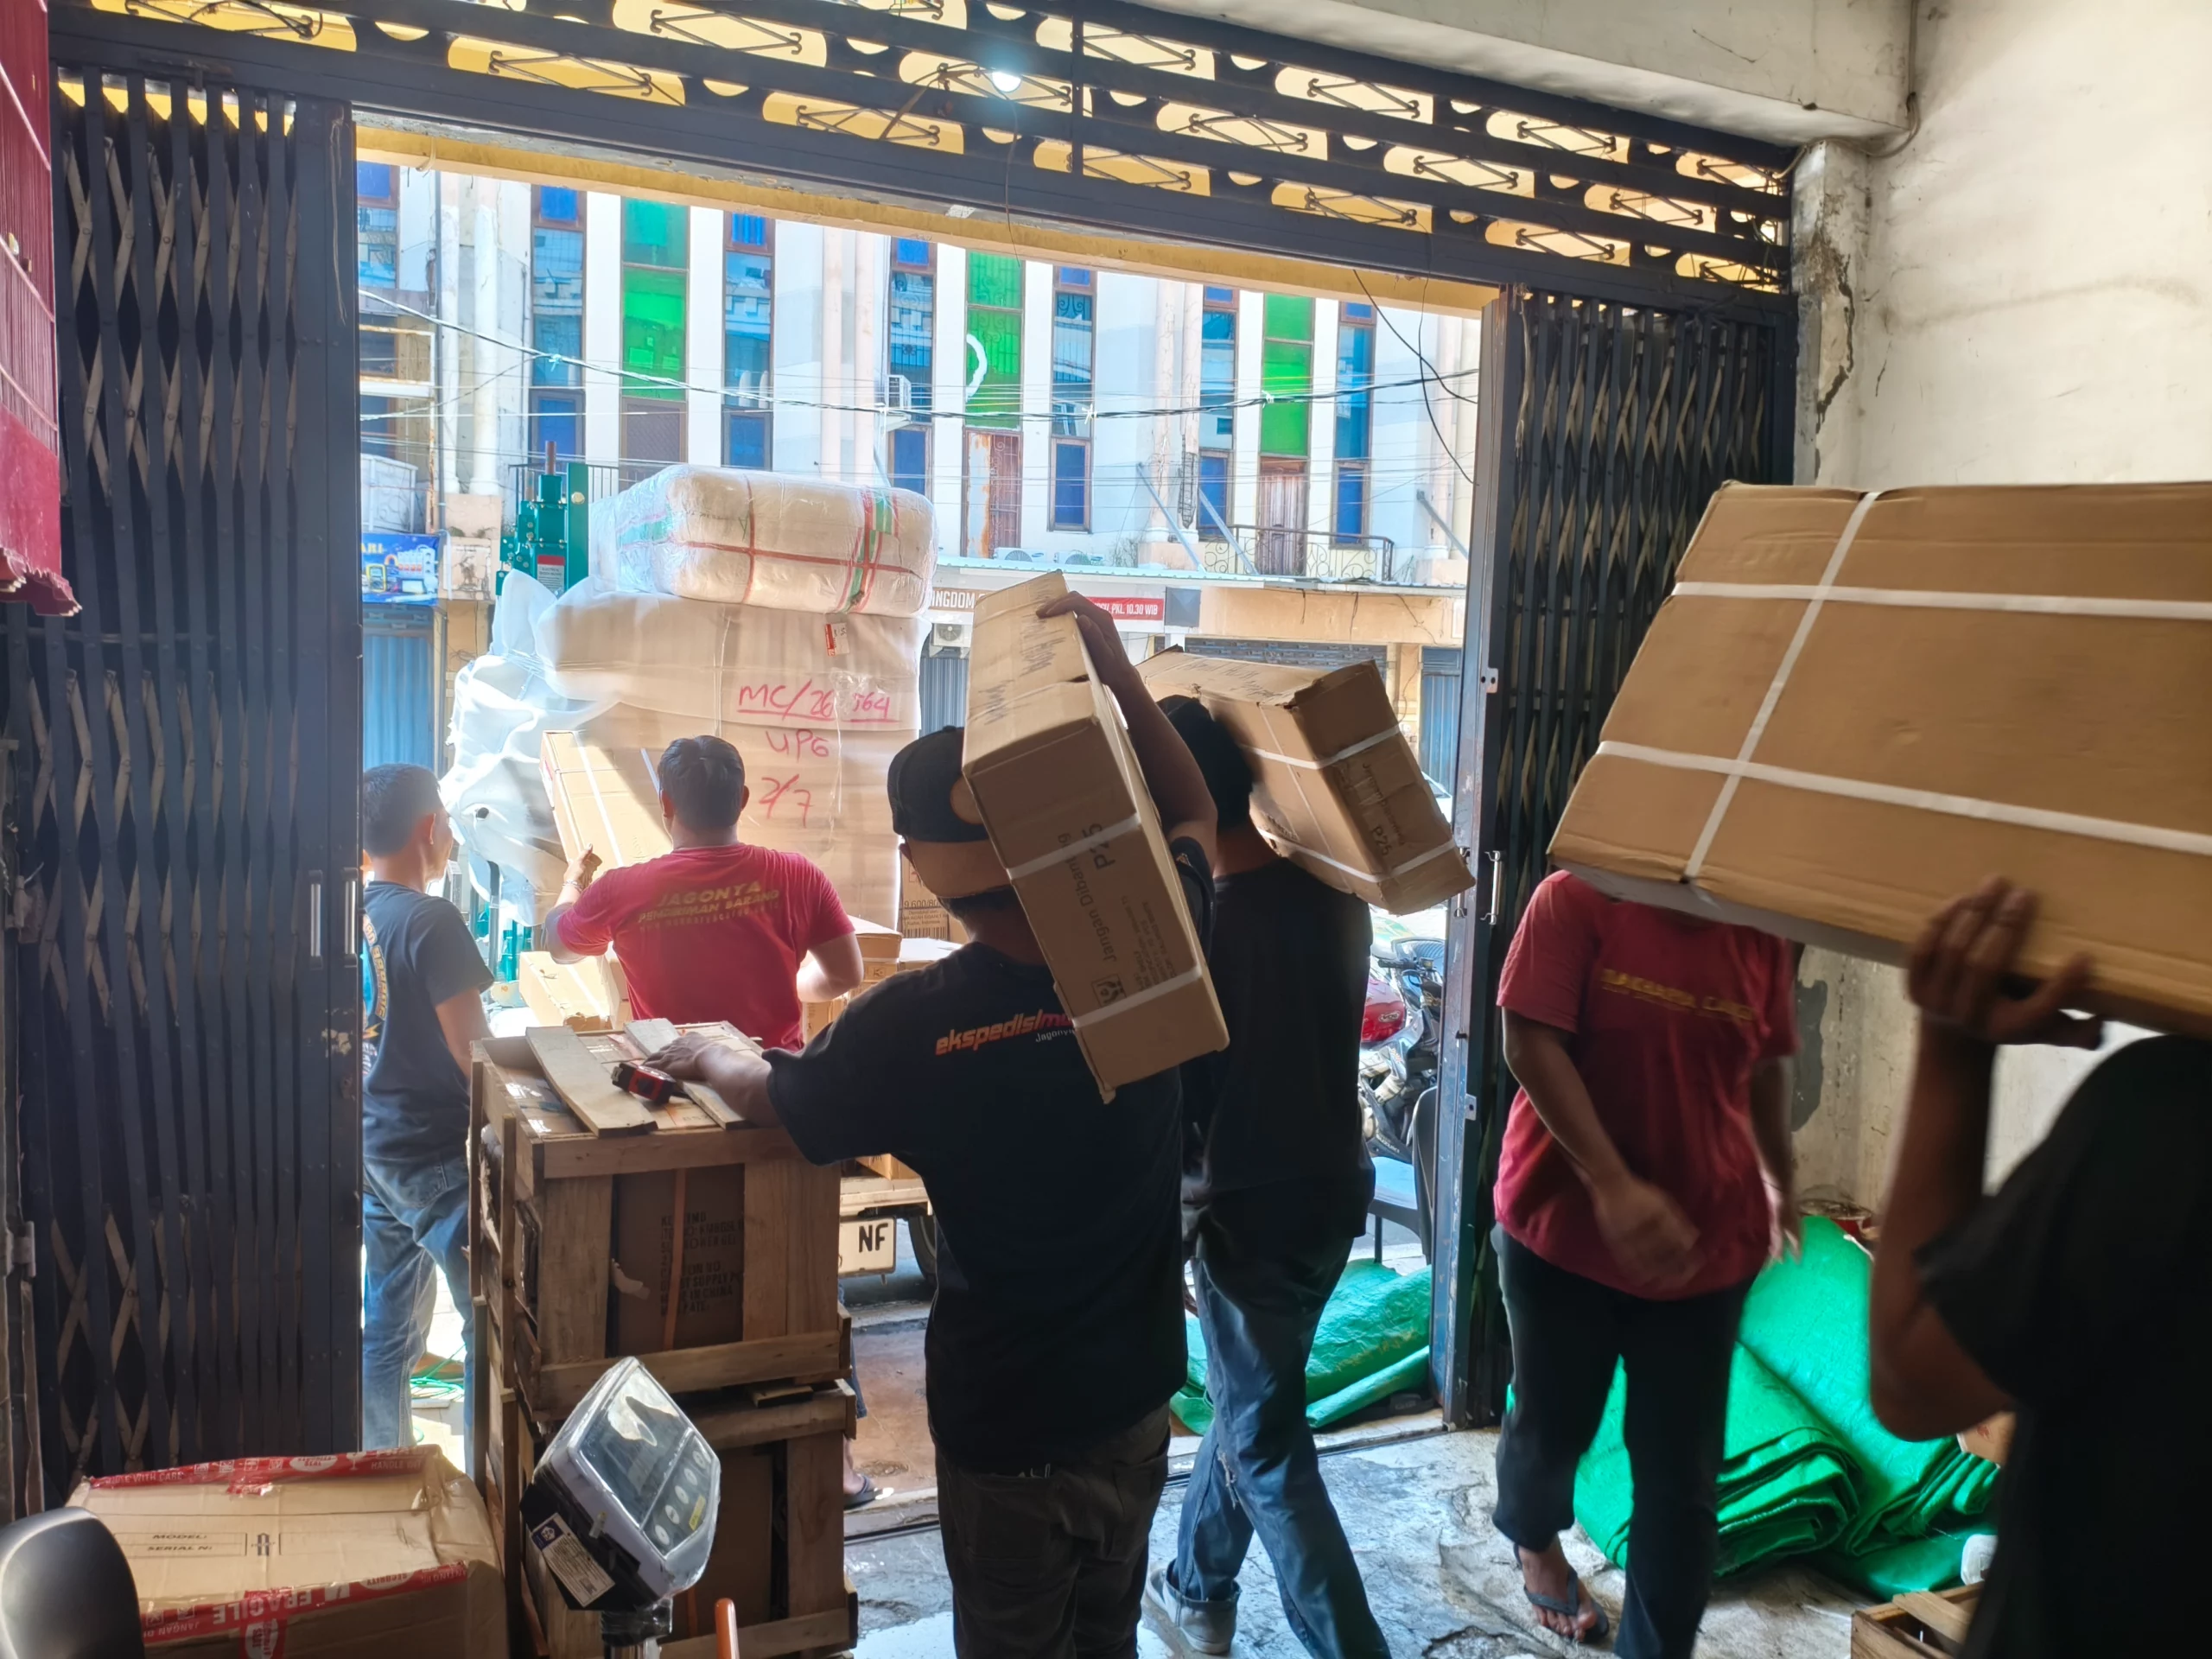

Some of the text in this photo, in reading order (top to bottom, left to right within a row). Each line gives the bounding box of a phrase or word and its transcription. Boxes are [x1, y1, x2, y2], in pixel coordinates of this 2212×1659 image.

[1145, 604, 1159, 615] WIB
[656, 880, 762, 907] JAGONYA
[725, 889, 780, 909] BARANG
[1088, 908, 1118, 963] Jangan
[859, 1223, 888, 1253] NF
[212, 1588, 313, 1625] FRAGILE
[158, 1621, 200, 1636] JANGAN
